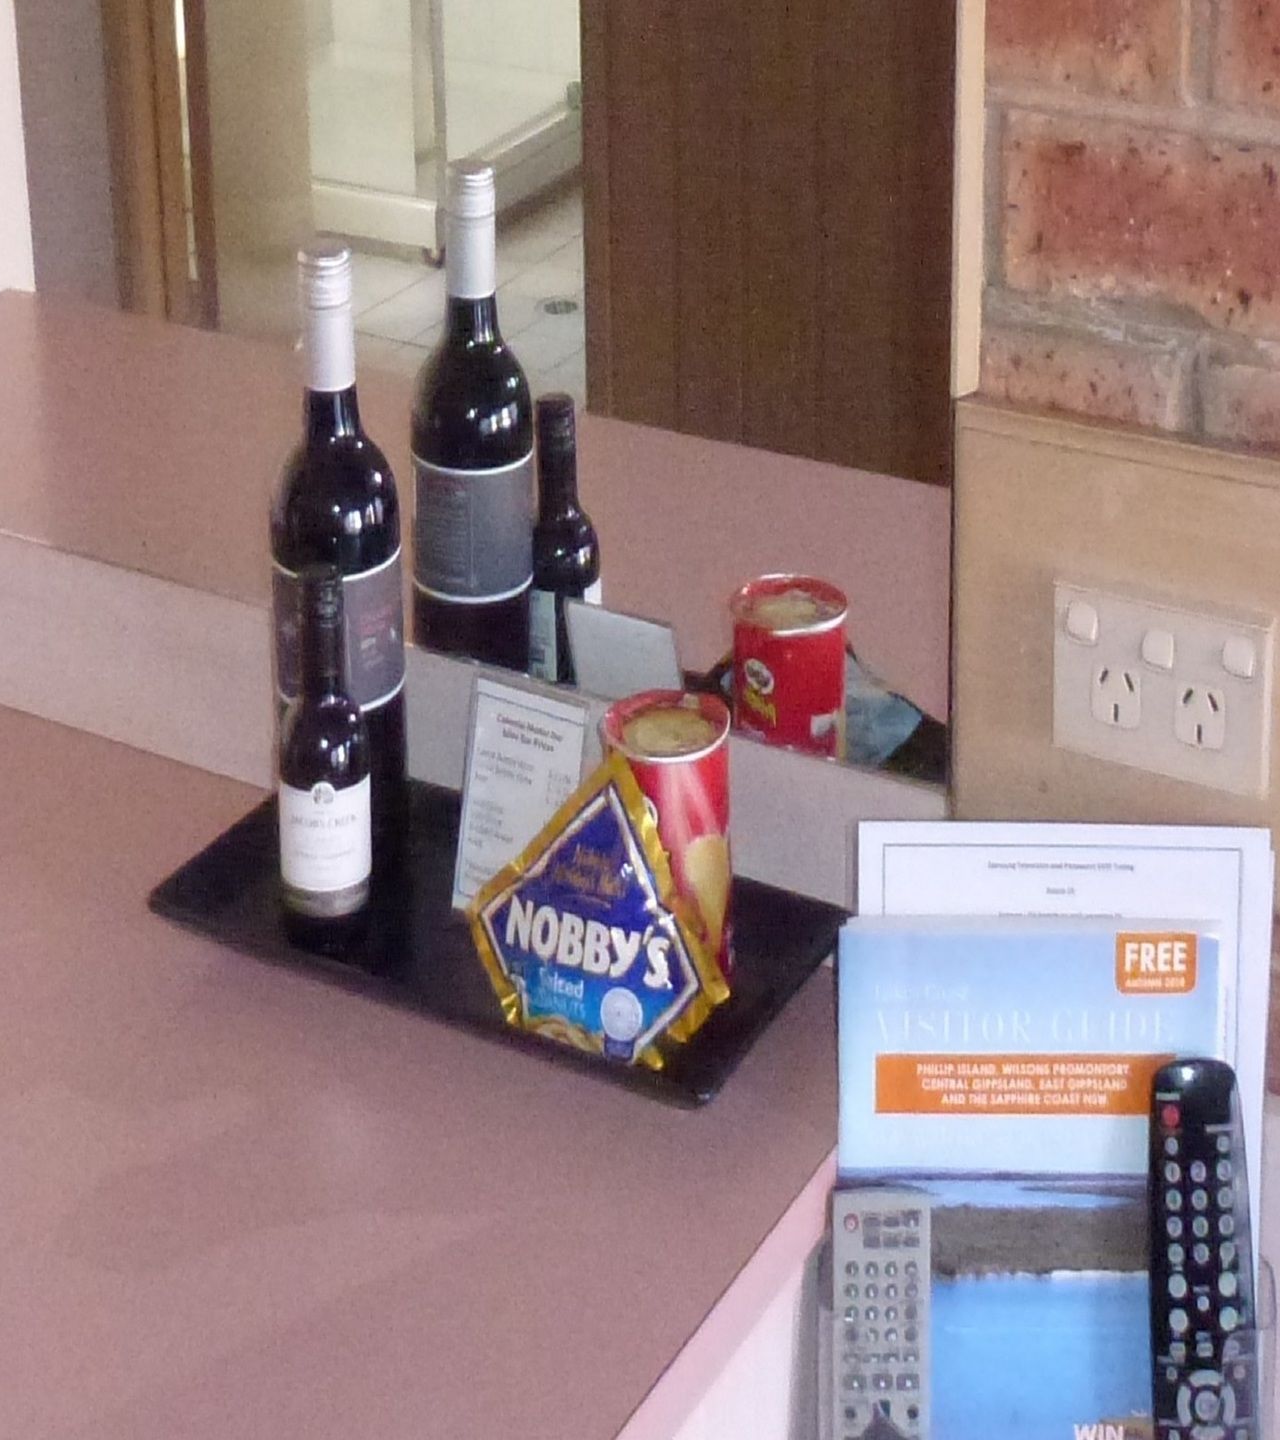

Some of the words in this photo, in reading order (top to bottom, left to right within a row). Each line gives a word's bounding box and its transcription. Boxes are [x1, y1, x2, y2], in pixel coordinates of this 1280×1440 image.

[505, 893, 673, 990] NOBBY'S
[1124, 941, 1188, 972] FREE
[876, 1010, 1032, 1044] VISITOR
[1052, 1011, 1176, 1044] GUIDE
[916, 1063, 956, 1075] PHILLIP
[1001, 1063, 1050, 1075] WILSONS
[921, 1078, 969, 1090] CENTRAL
[1039, 1079, 1064, 1090] EAST
[1068, 1078, 1128, 1090] GIPPSLAND
[941, 1093, 966, 1105] AND
[968, 1093, 988, 1105] THE
[990, 1093, 1041, 1105] SAPPHIRE
[1043, 1093, 1081, 1105] COAST
[1083, 1093, 1108, 1105] NSW
